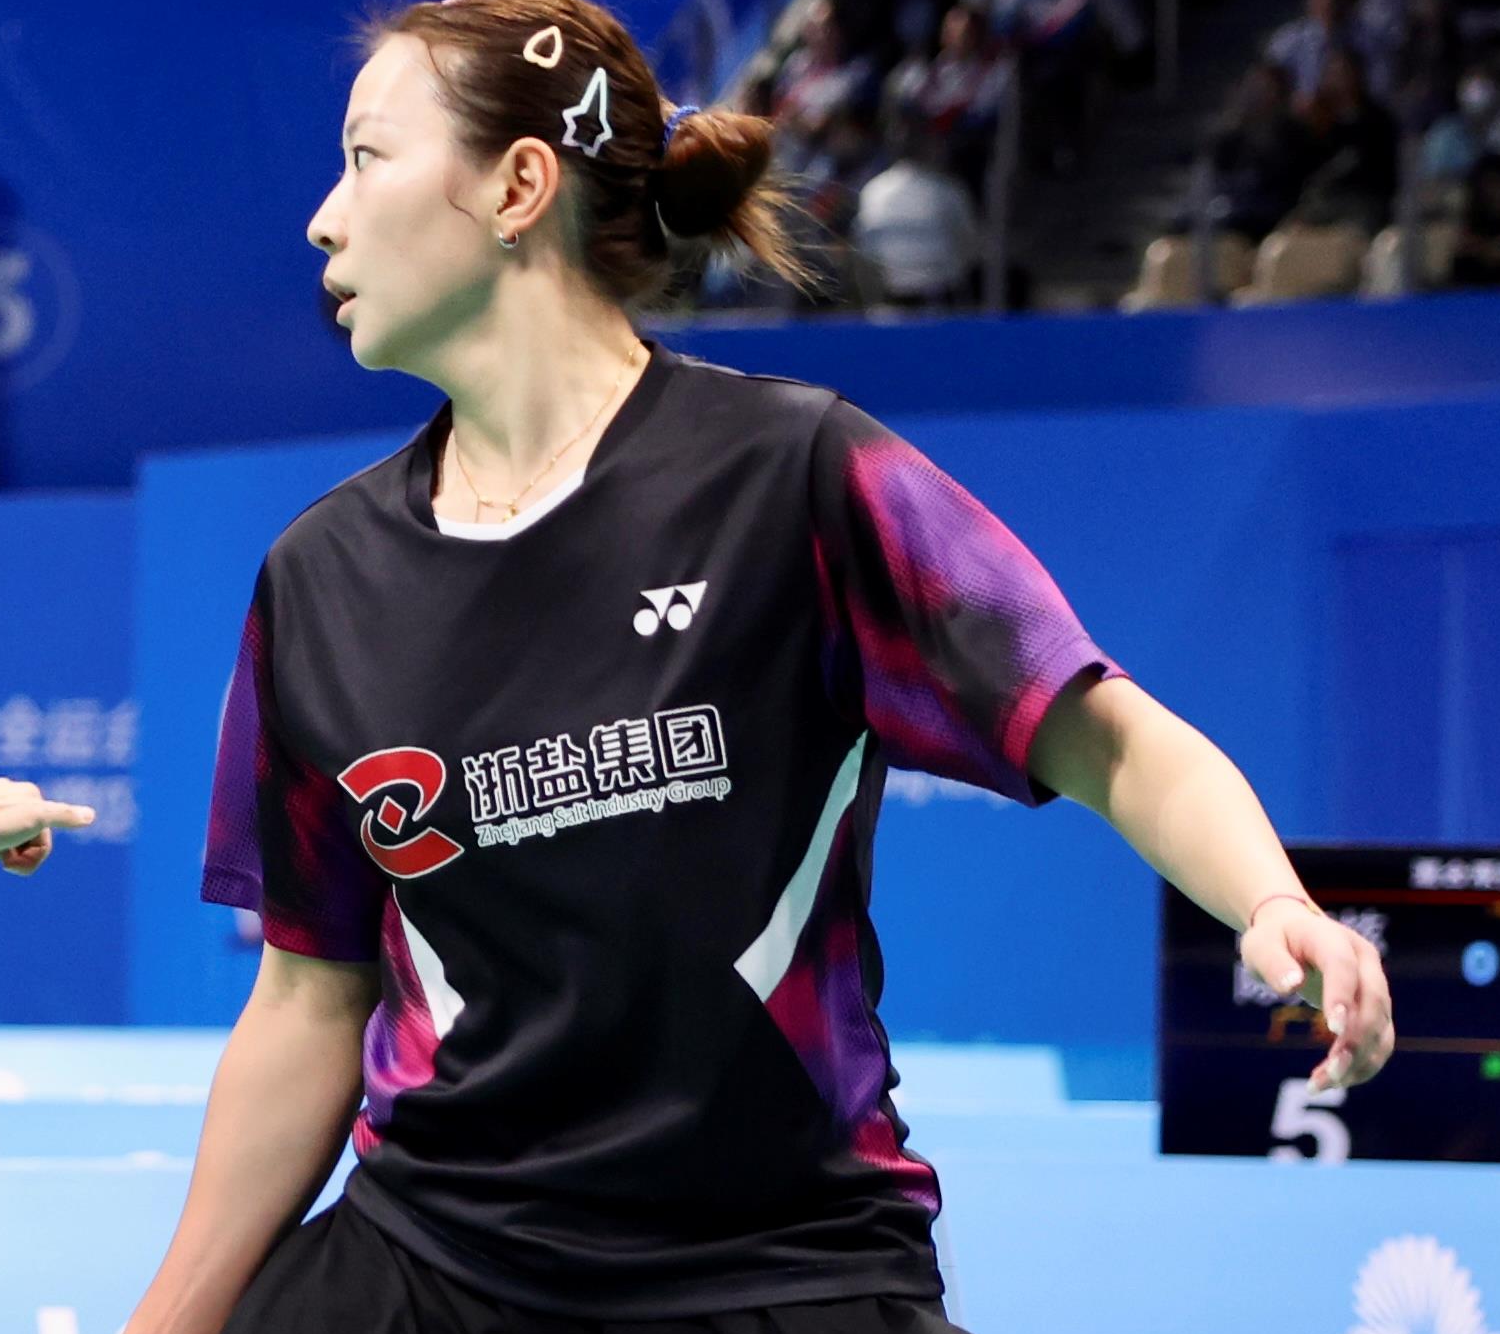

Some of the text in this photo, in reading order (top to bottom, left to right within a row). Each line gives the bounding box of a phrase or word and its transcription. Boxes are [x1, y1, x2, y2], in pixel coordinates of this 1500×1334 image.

[461, 704, 728, 823] 浙盐集团
[474, 776, 732, 848] Zhejiang Salt Industry Group
[1269, 1078, 1351, 1164] 5
